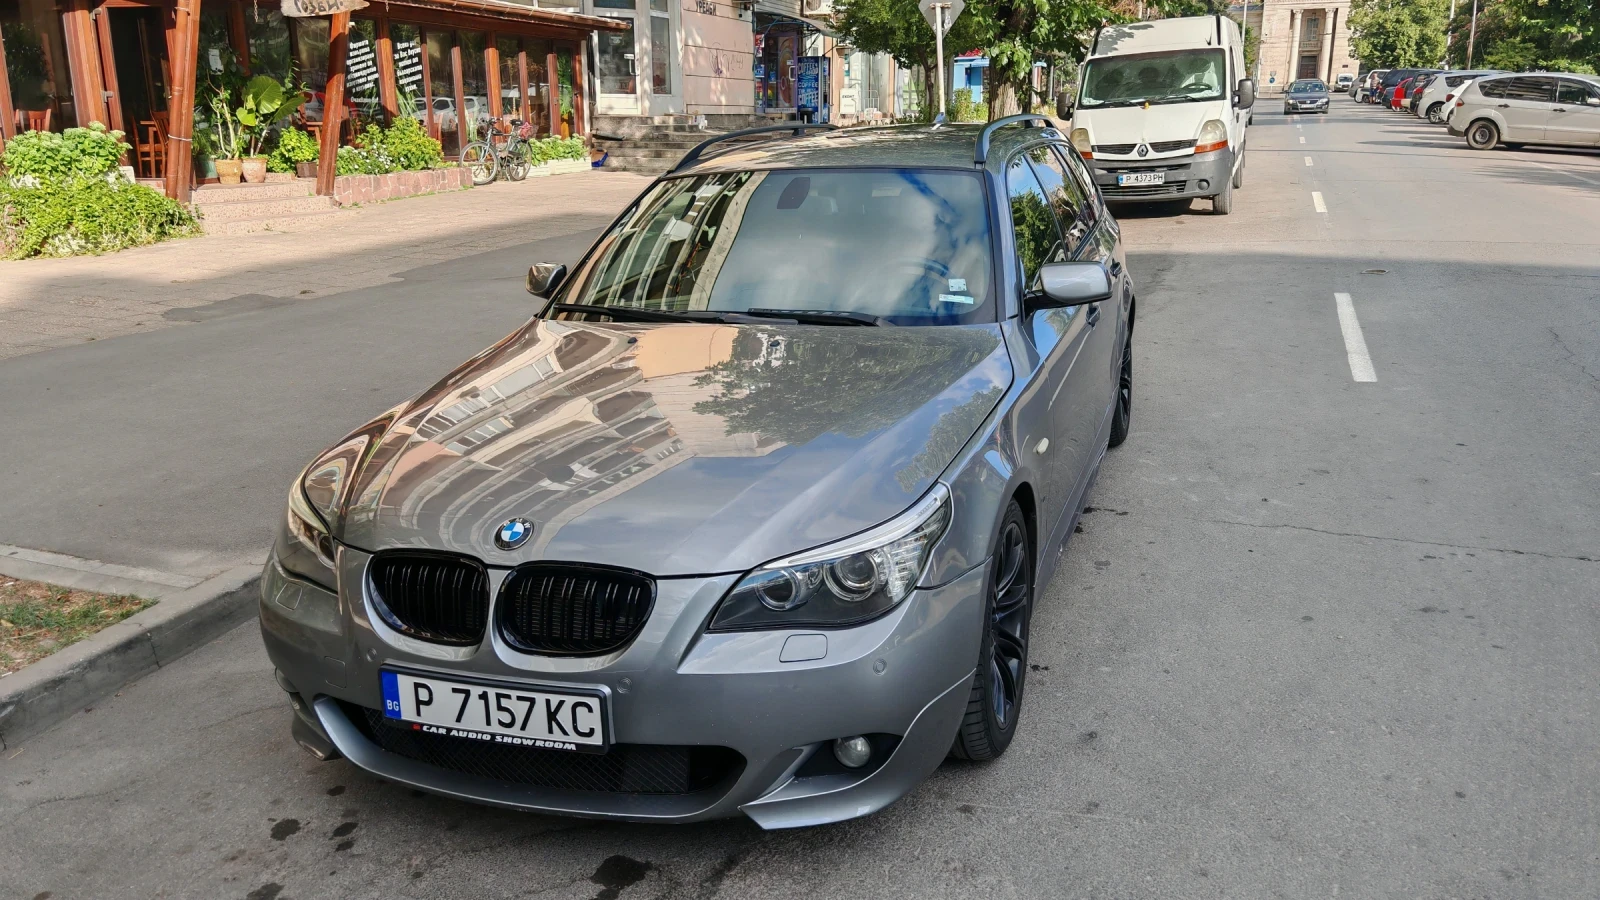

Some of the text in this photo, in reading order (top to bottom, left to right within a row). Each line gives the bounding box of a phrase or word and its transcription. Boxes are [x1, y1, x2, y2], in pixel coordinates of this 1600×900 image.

[386, 699, 400, 712] BG
[413, 682, 595, 738] P 7157 KC
[422, 725, 577, 751] CAR AUDIO SHOWROOM
